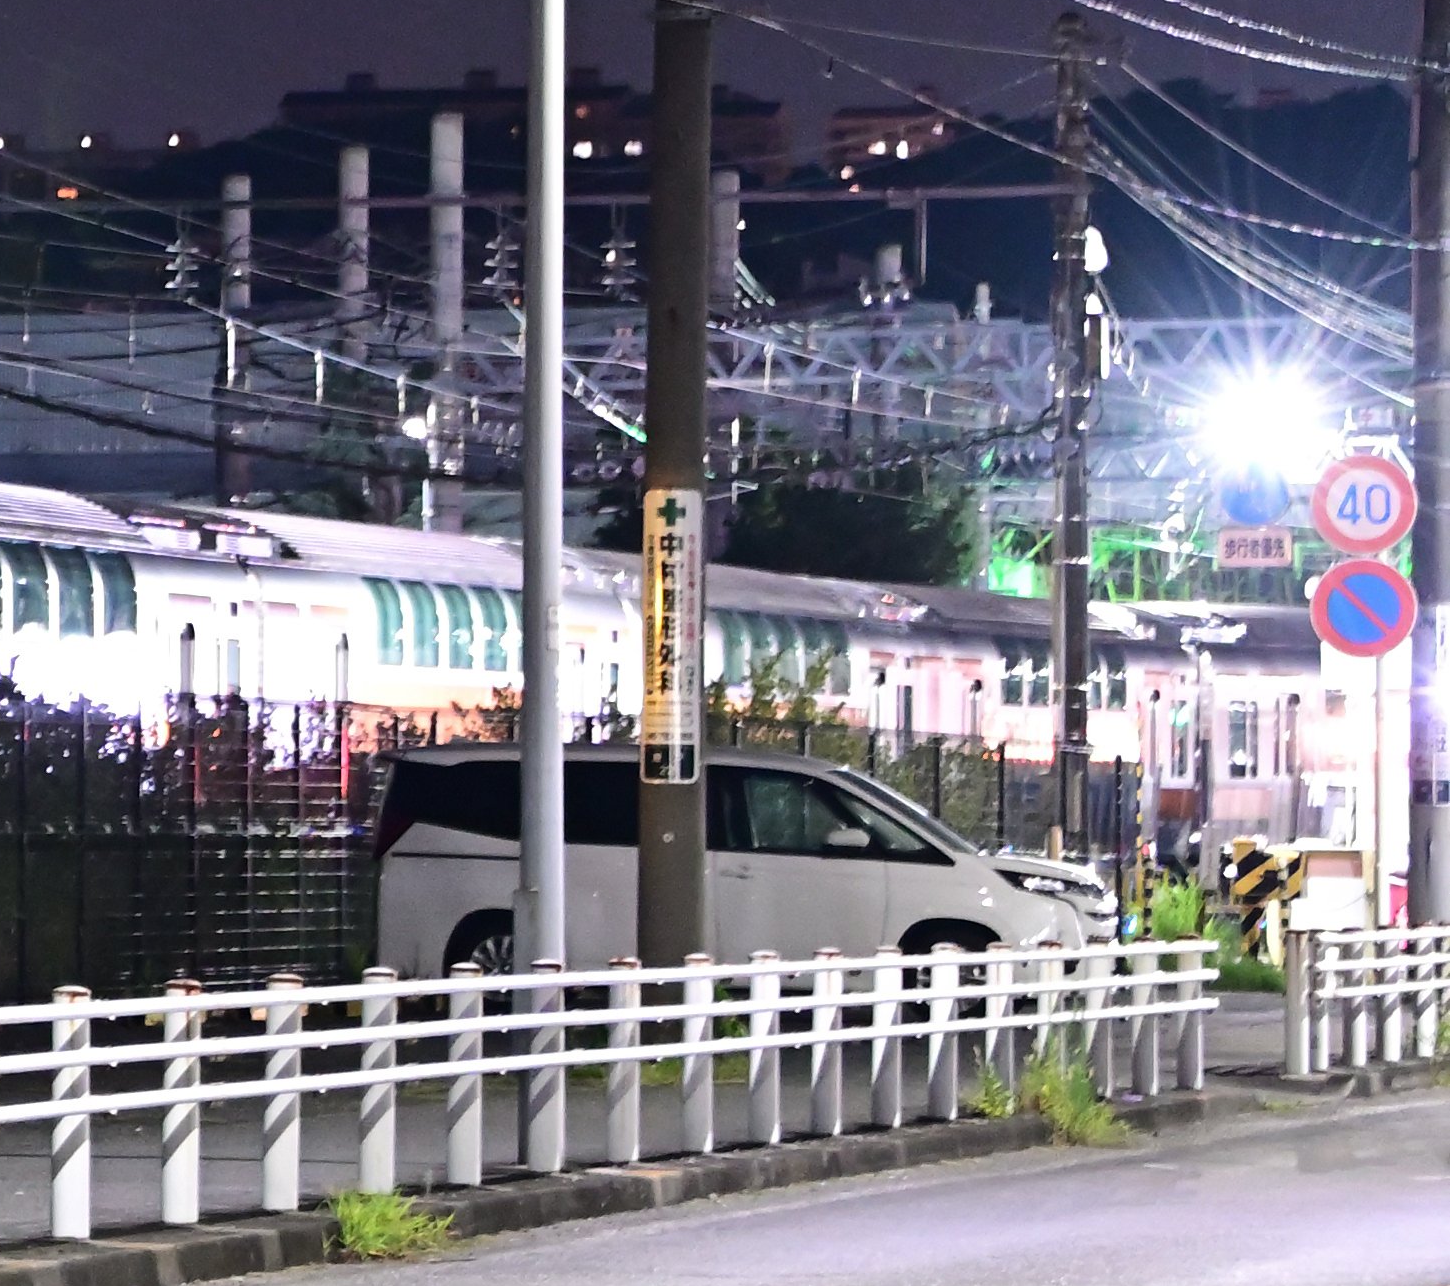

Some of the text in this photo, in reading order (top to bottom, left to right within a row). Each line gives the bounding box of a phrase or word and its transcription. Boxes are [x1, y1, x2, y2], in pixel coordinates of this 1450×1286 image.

[1336, 484, 1392, 526] 40
[1224, 536, 1285, 559] 歩行者優先
